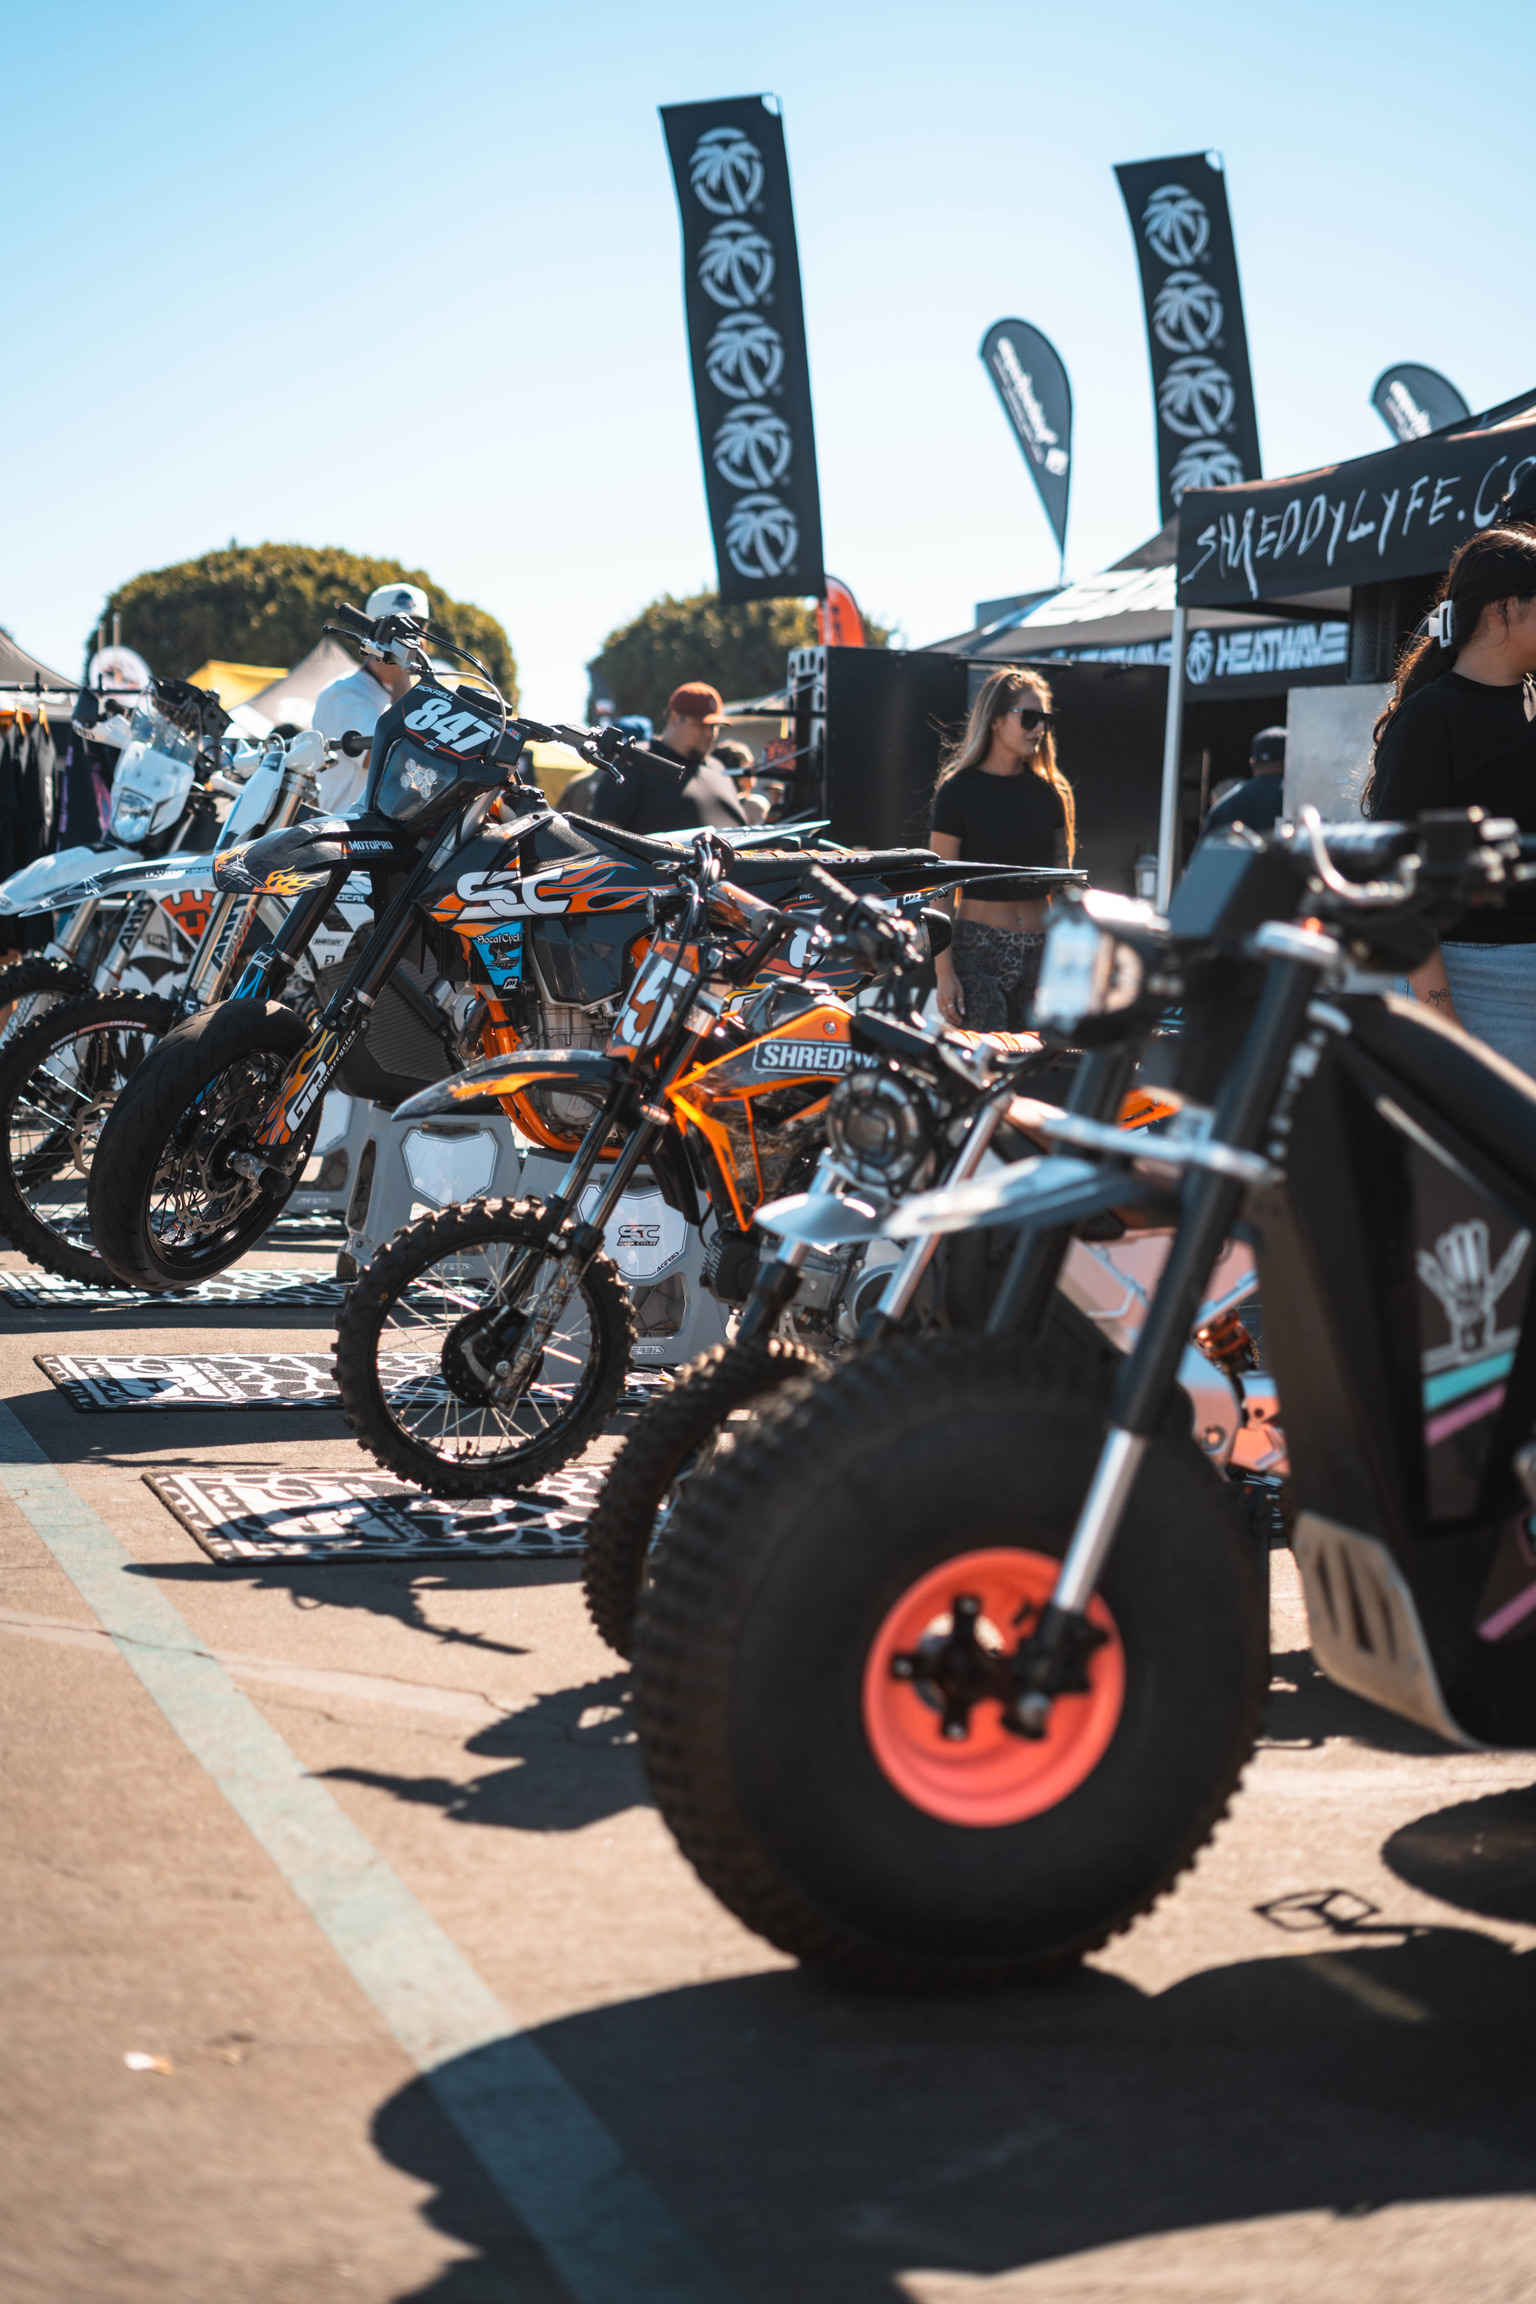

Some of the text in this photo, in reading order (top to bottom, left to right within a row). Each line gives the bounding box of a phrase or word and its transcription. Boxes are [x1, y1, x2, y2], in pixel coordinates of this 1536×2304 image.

[1215, 621, 1348, 676] HEATWAVE
[404, 698, 500, 753] 847
[336, 893, 366, 903] OCAL
[477, 934, 501, 945] Socal
[621, 958, 692, 1047] 5
[317, 1029, 356, 1091] Motorcycles
